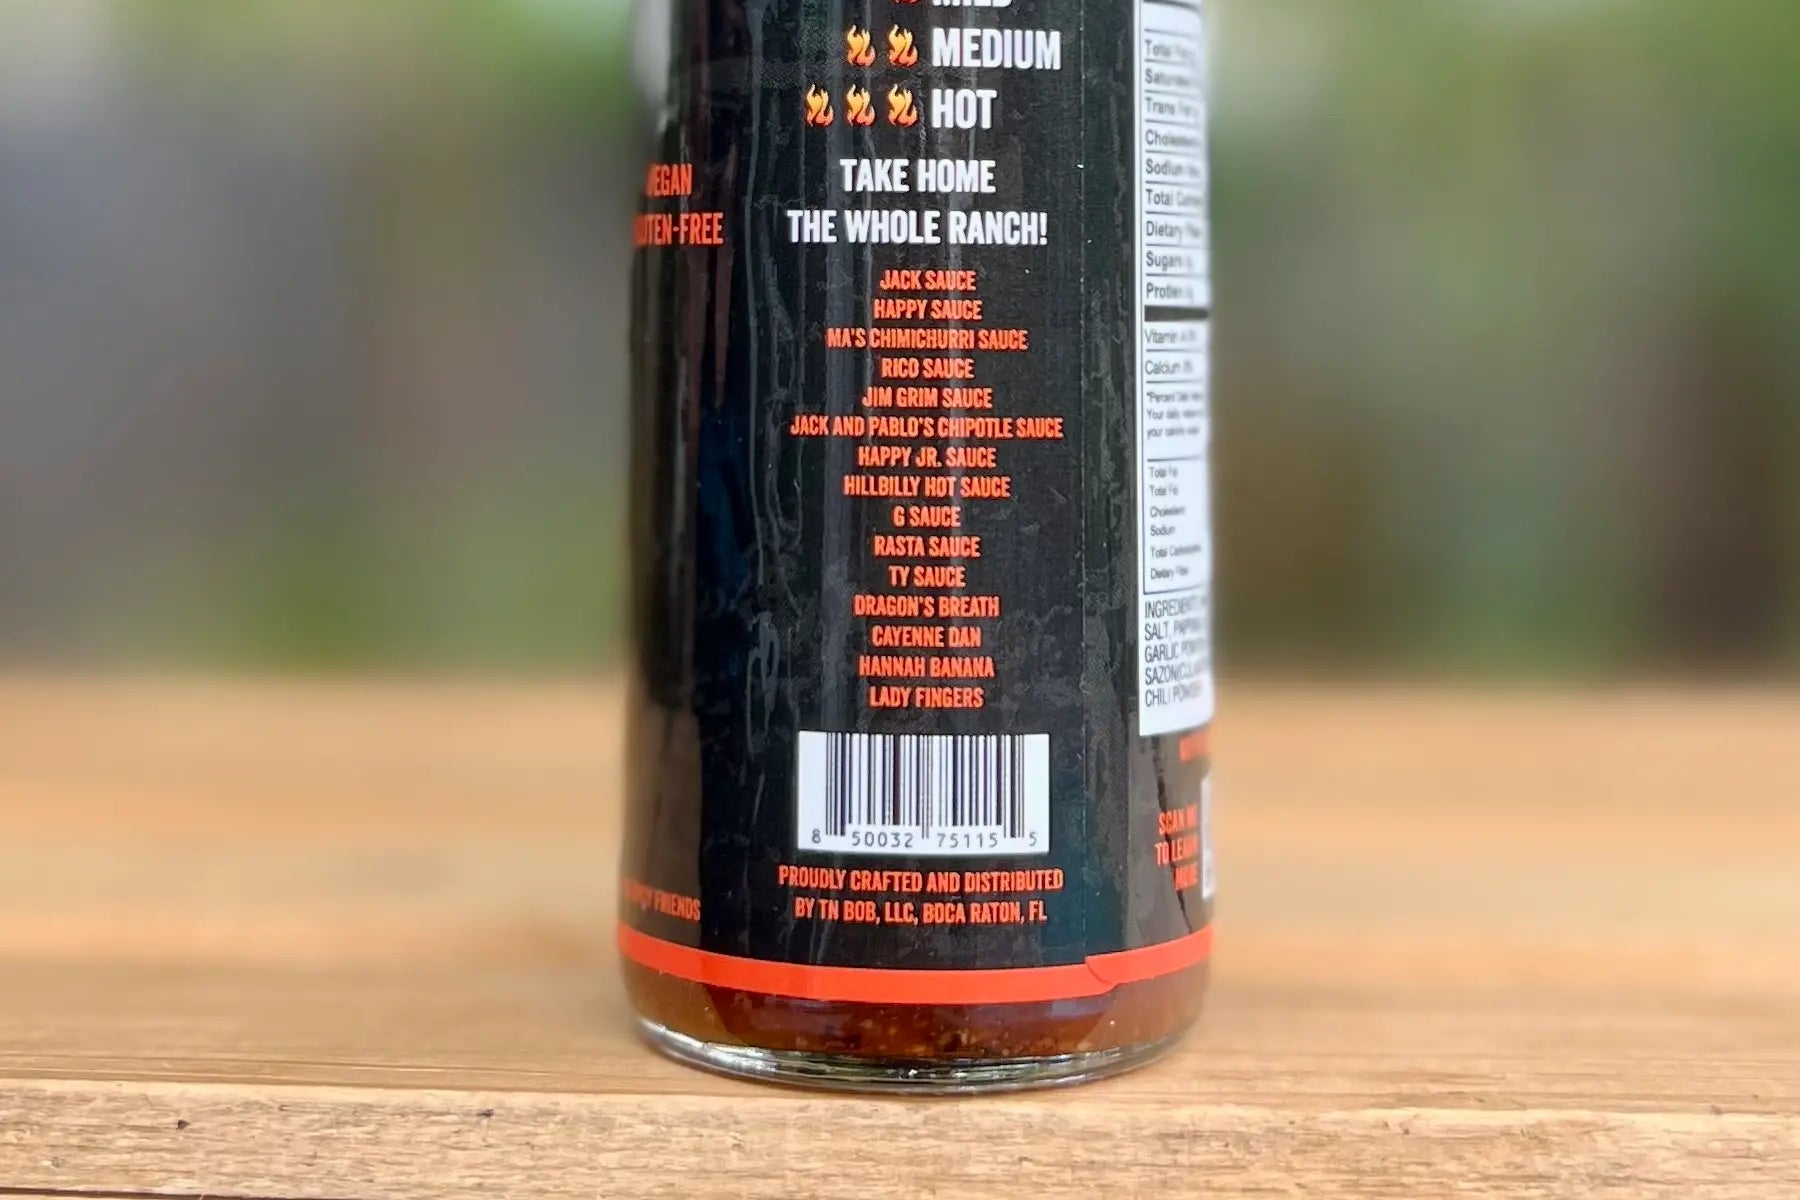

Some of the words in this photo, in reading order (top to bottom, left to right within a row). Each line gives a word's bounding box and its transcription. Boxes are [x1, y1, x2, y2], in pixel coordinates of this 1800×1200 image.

[932, 28, 1061, 70] MEDIUM
[931, 88, 997, 129] HOT
[840, 159, 910, 192] TAKE
[917, 159, 996, 193] HOME
[787, 210, 837, 243] THE
[844, 210, 940, 244] WHOLE
[948, 211, 1047, 245] RANCH!
[880, 270, 921, 291] JACK
[925, 270, 976, 291] SAUCE
[874, 299, 929, 320] HAPPY
[930, 300, 982, 321] SAUCE
[826, 328, 866, 348] MA'S
[869, 328, 974, 349] CHIMICHURRI
[978, 329, 1028, 350] SAUCE
[881, 358, 919, 378] RICO
[922, 358, 974, 379] SAUCE
[863, 387, 892, 407] JIM
[896, 387, 938, 408] GRIM
[942, 388, 993, 409] SAUCE
[791, 416, 829, 435] JACK
[833, 416, 864, 436] AND
[868, 416, 934, 437] PABLO'S
[938, 417, 1013, 438] CHIPOTLE
[1016, 418, 1063, 438] SAUCE
[859, 447, 912, 467] HAPPY
[915, 447, 942, 468] JR.
[946, 447, 997, 468] SAUCE
[844, 476, 920, 497] HILLBILLY
[925, 476, 955, 497] HOT
[960, 476, 1010, 498] SAUCE
[893, 506, 905, 527] G
[909, 506, 961, 527] SAUCE
[874, 536, 925, 557] RASTA
[928, 536, 981, 557] SAUCE
[888, 566, 910, 587] TY
[913, 566, 966, 588] SAUCE
[854, 596, 934, 617] DRAGON'S
[939, 596, 999, 617] BREATH
[872, 626, 945, 647] CAYENNE
[949, 627, 981, 648] DAN
[1145, 642, 1179, 663] GARLIC
[859, 656, 925, 677] HANNAH
[930, 657, 994, 678] BANANA
[870, 686, 911, 707] LADY
[915, 687, 984, 708] FINGERS
[1159, 808, 1185, 836] SCAN
[812, 829, 821, 843] 8
[851, 831, 913, 848] 50032
[937, 832, 998, 848] 75115
[1029, 831, 1037, 846] 5
[1155, 841, 1169, 867] TO
[778, 865, 846, 890] PROUDLY
[851, 869, 922, 892] CRAFTED
[926, 871, 960, 892] AND
[964, 869, 1064, 892] DISTRIBUTED
[655, 889, 701, 920] FRIENDS
[795, 897, 815, 918] BY
[818, 899, 839, 921] TN
[843, 900, 880, 924] BOB,
[885, 902, 918, 925] LLC,
[923, 902, 966, 923] BOCA
[970, 901, 1025, 924] RATON,
[1029, 900, 1048, 921] FL
